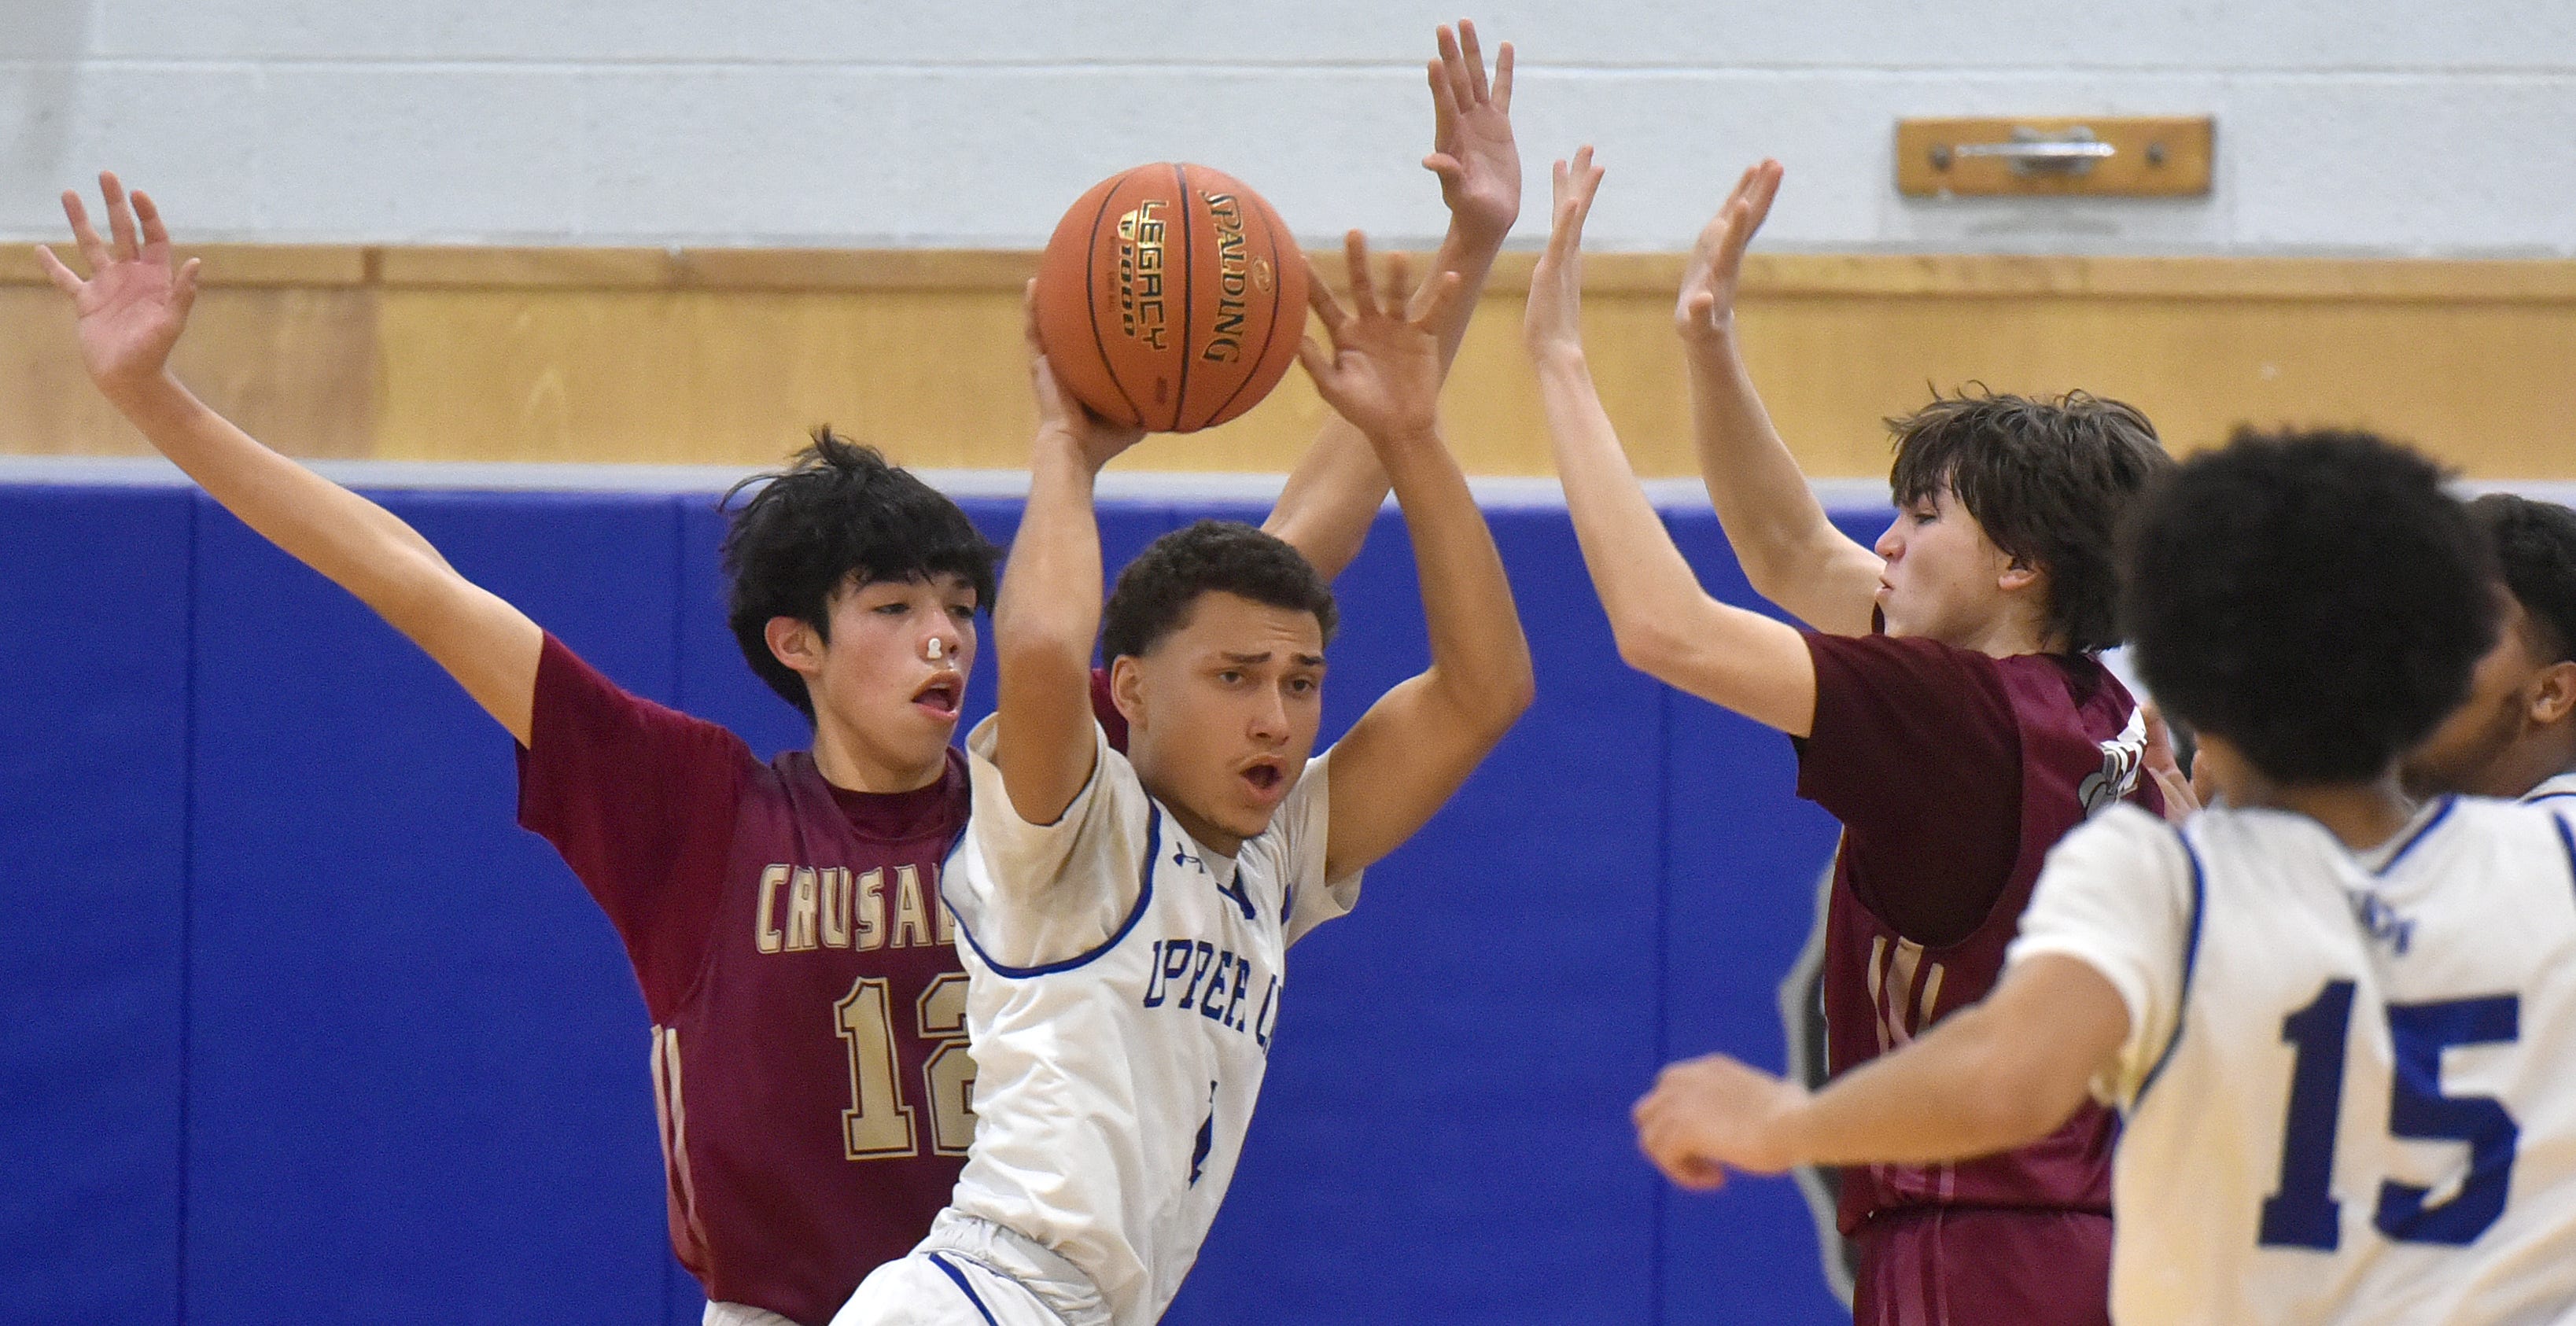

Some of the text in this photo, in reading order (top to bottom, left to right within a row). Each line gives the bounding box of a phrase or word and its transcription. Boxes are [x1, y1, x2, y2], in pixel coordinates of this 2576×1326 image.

[1137, 200, 1169, 351] LEGACY
[1197, 190, 1247, 365] SPALDING
[834, 971, 978, 1161] 12
[1143, 938, 1251, 1033] UPPER
[2256, 978, 2521, 1253] 15
